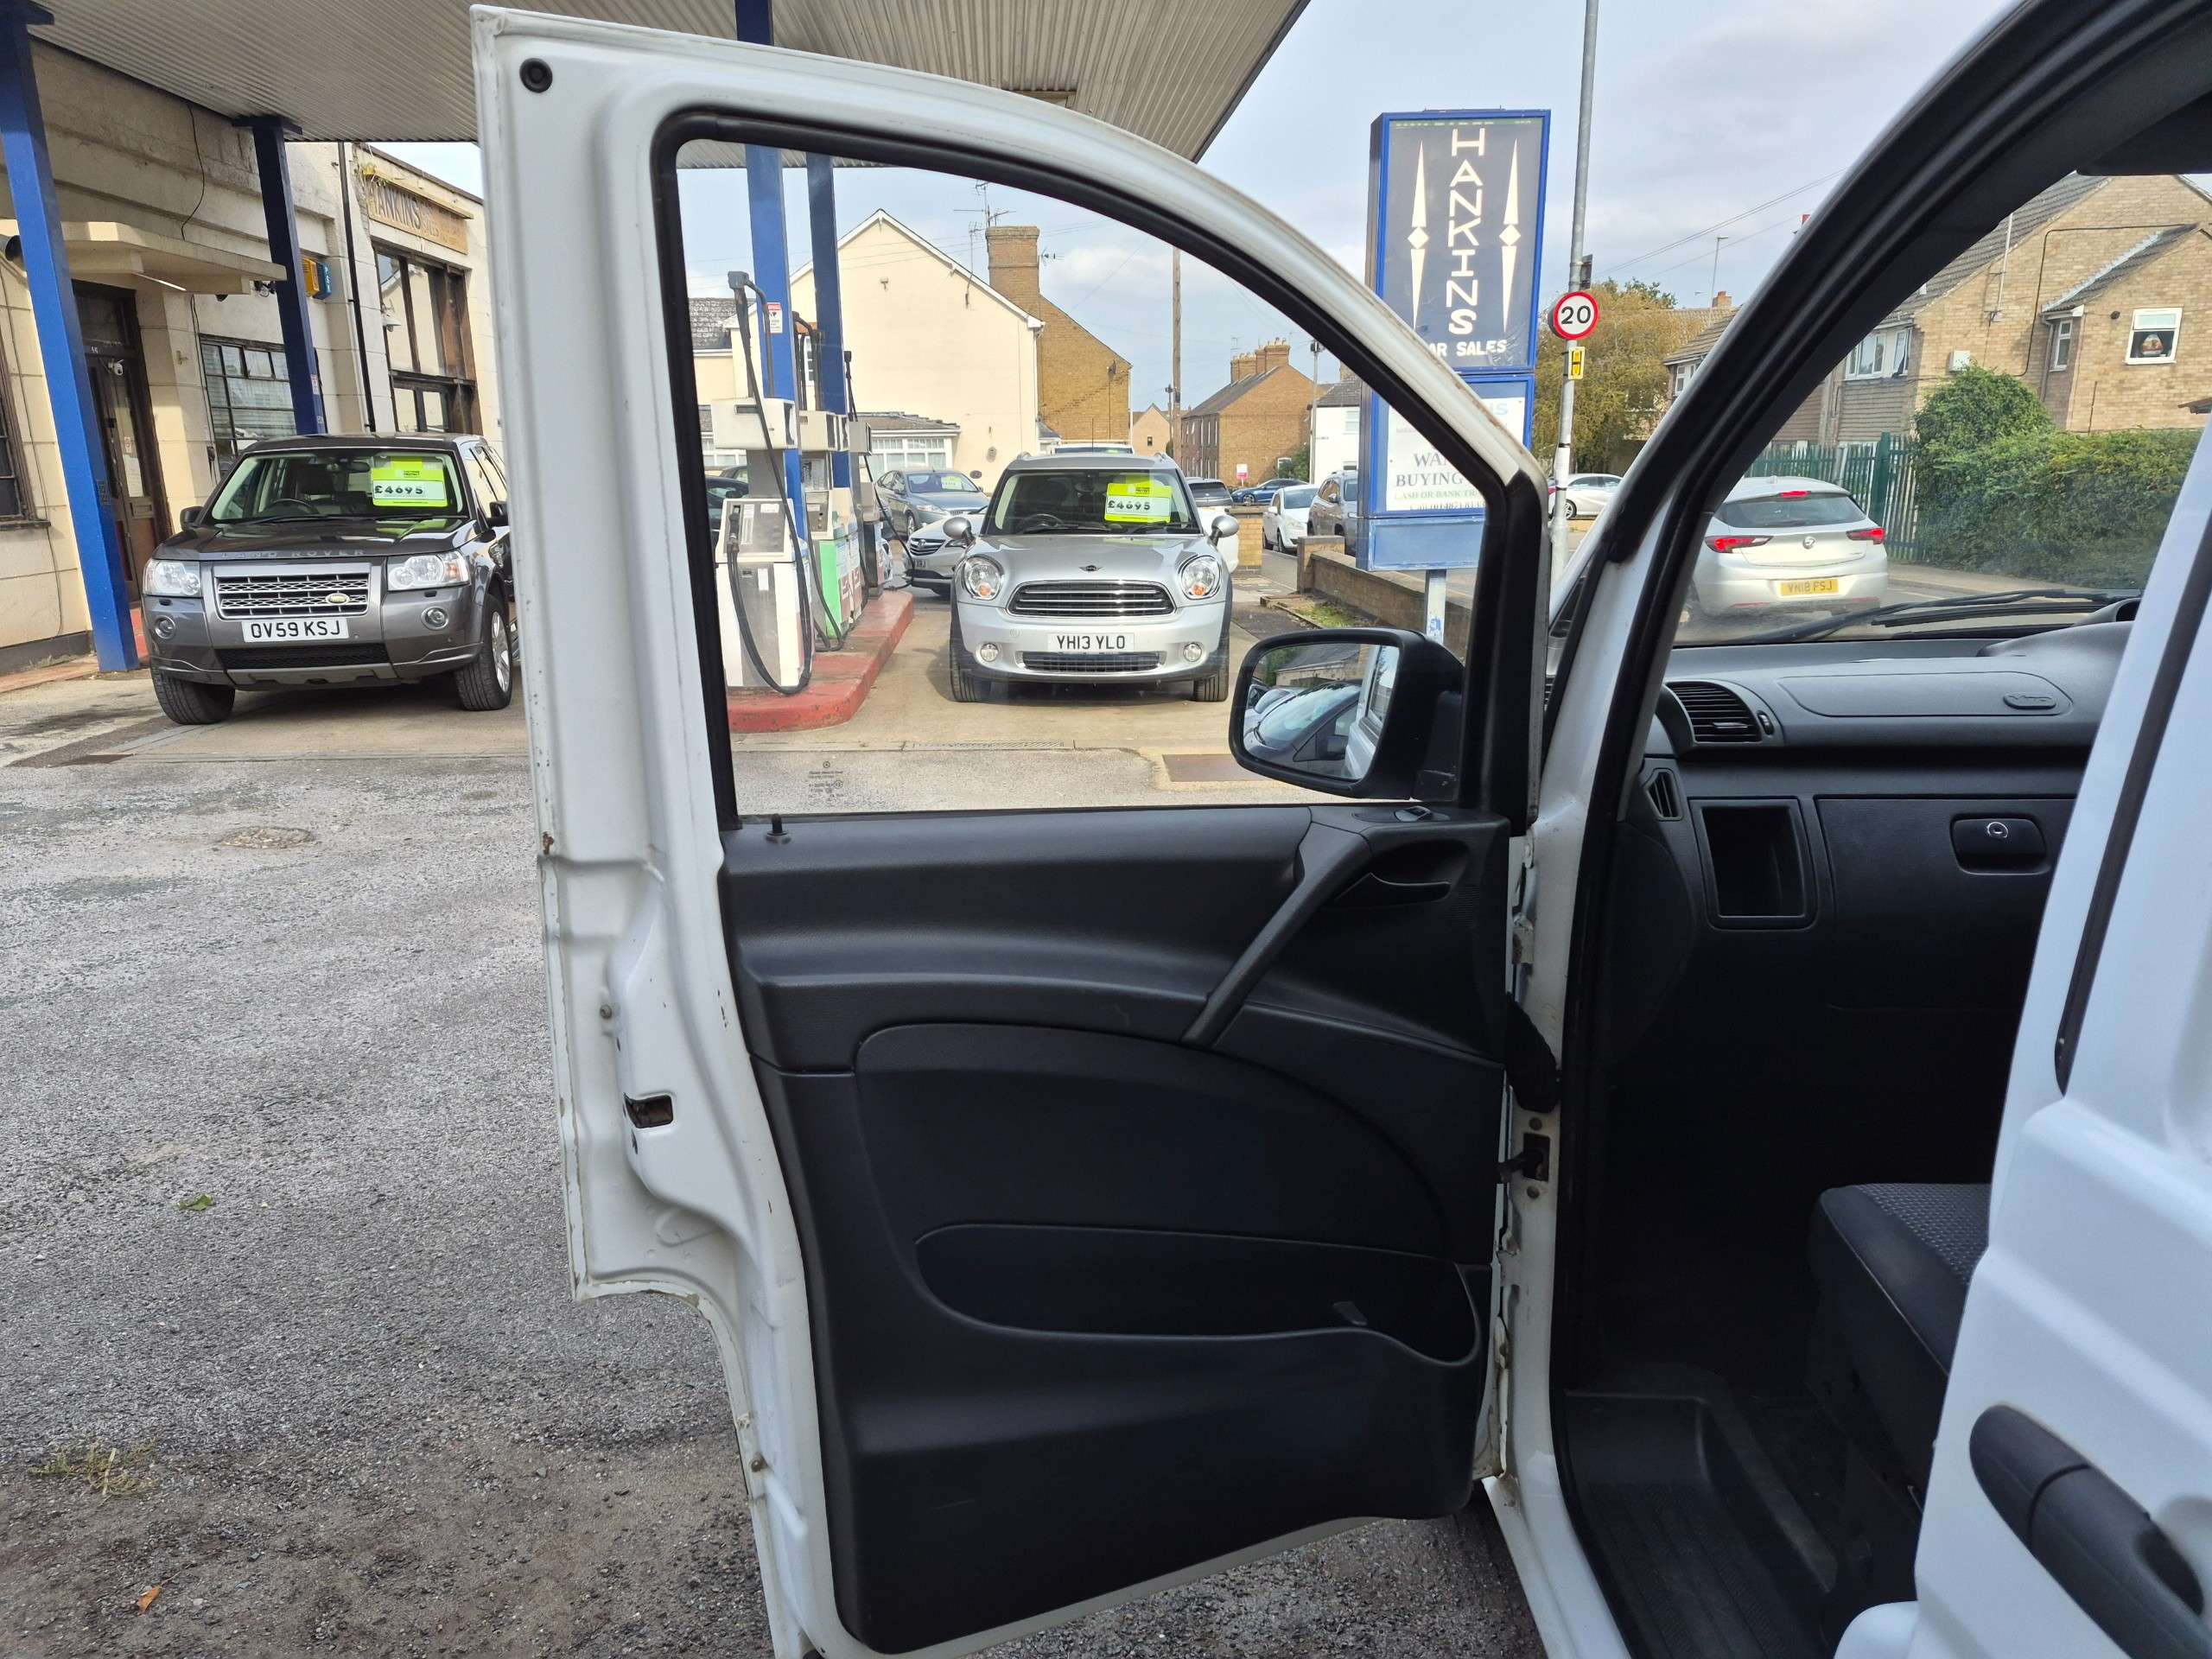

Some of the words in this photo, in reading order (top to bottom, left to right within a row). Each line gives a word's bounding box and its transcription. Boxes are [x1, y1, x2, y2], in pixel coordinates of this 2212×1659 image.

[1446, 128, 1485, 335] HANKINS
[1560, 305, 1592, 324] 20
[1427, 342, 1447, 357] AR
[1456, 340, 1508, 357] SALES
[1396, 472, 1463, 487] BUYING
[251, 621, 299, 639] OV59
[304, 620, 340, 637] KSJ
[1057, 635, 1090, 649] YH13
